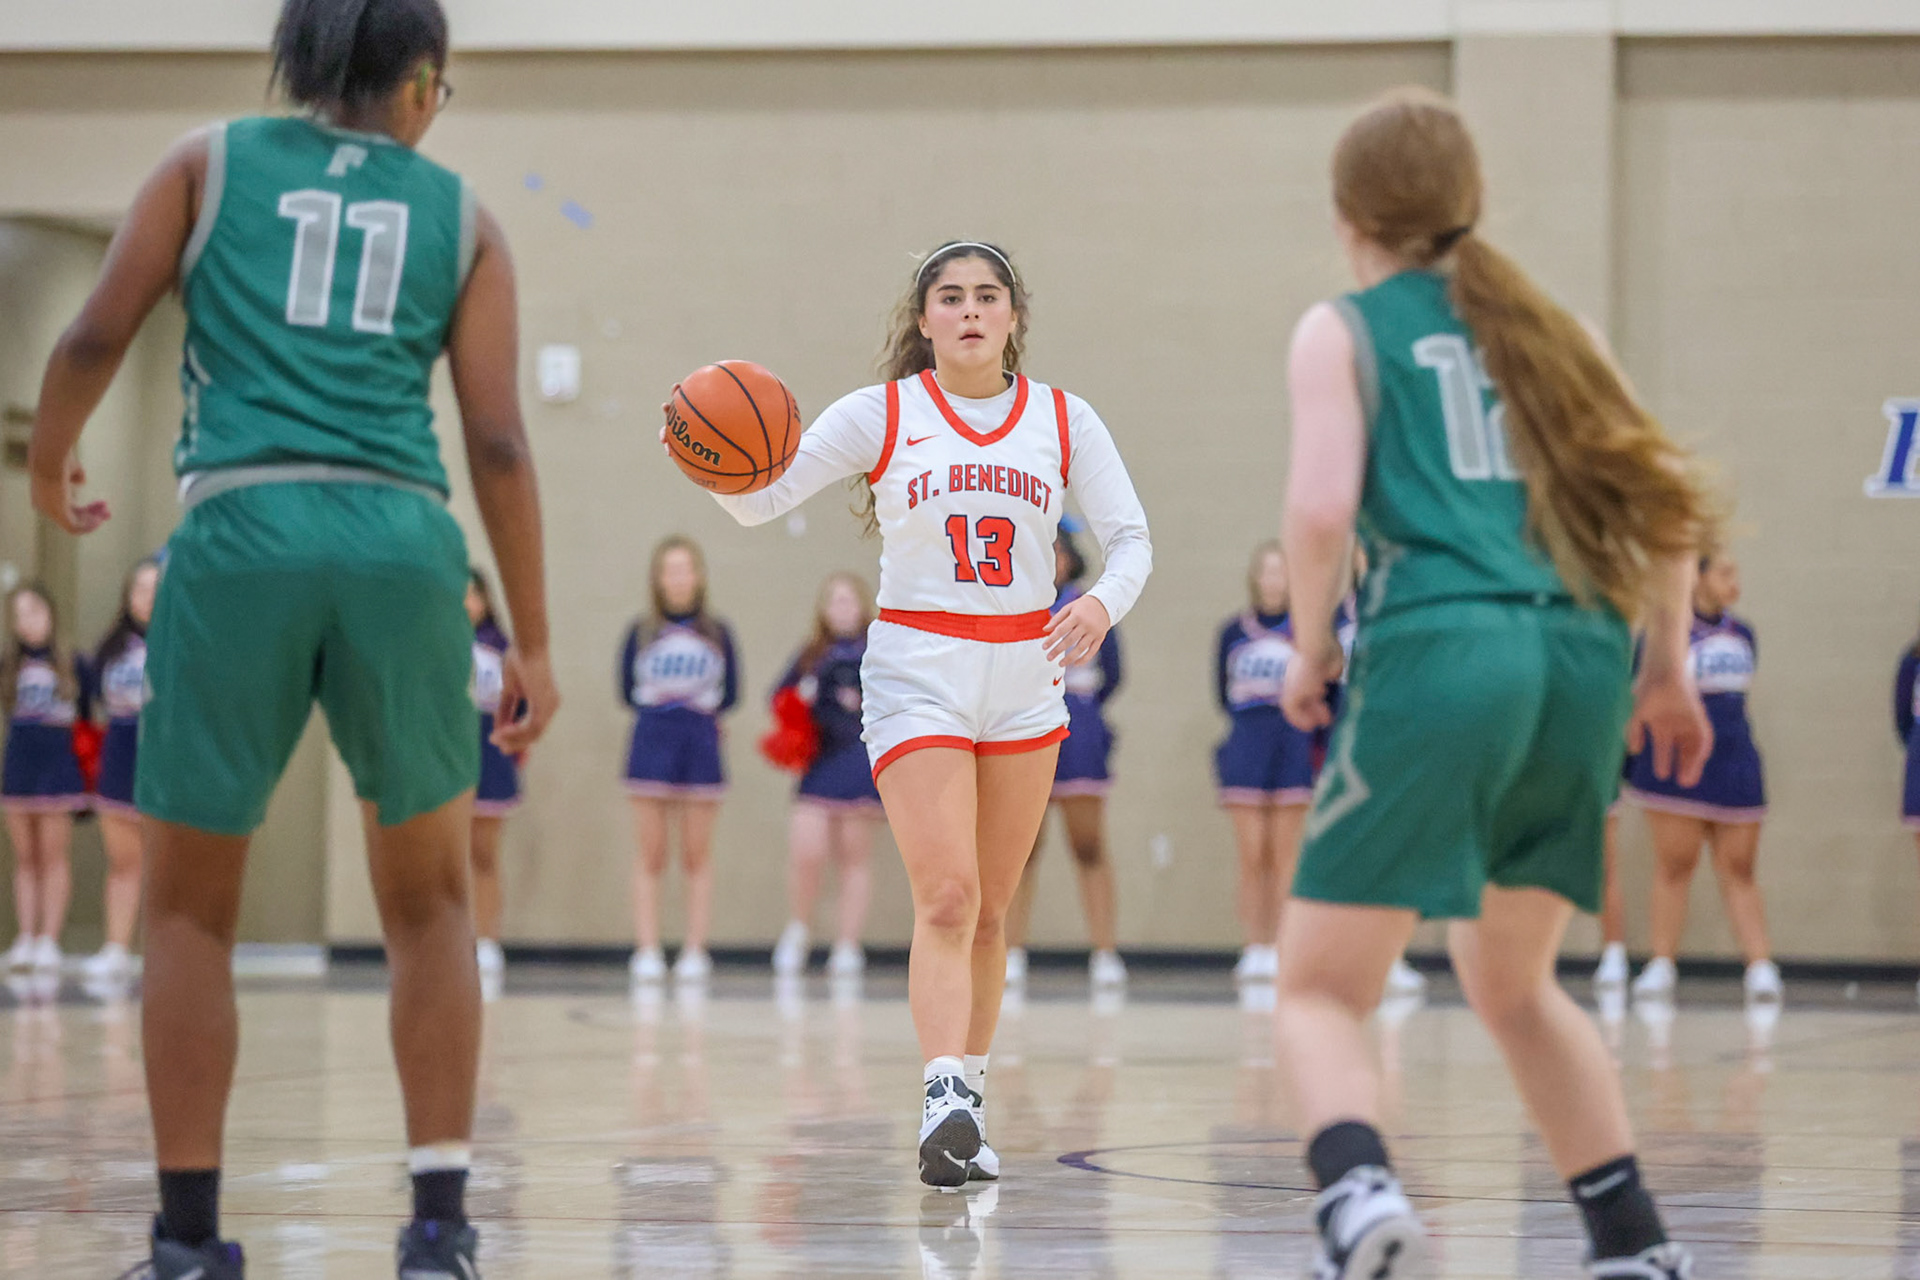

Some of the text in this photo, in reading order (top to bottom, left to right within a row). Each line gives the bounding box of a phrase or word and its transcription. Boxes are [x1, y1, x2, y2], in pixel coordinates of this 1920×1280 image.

[278, 189, 409, 335] 11
[908, 464, 1052, 514] ST. BENEDICT
[944, 514, 1016, 587] 13
